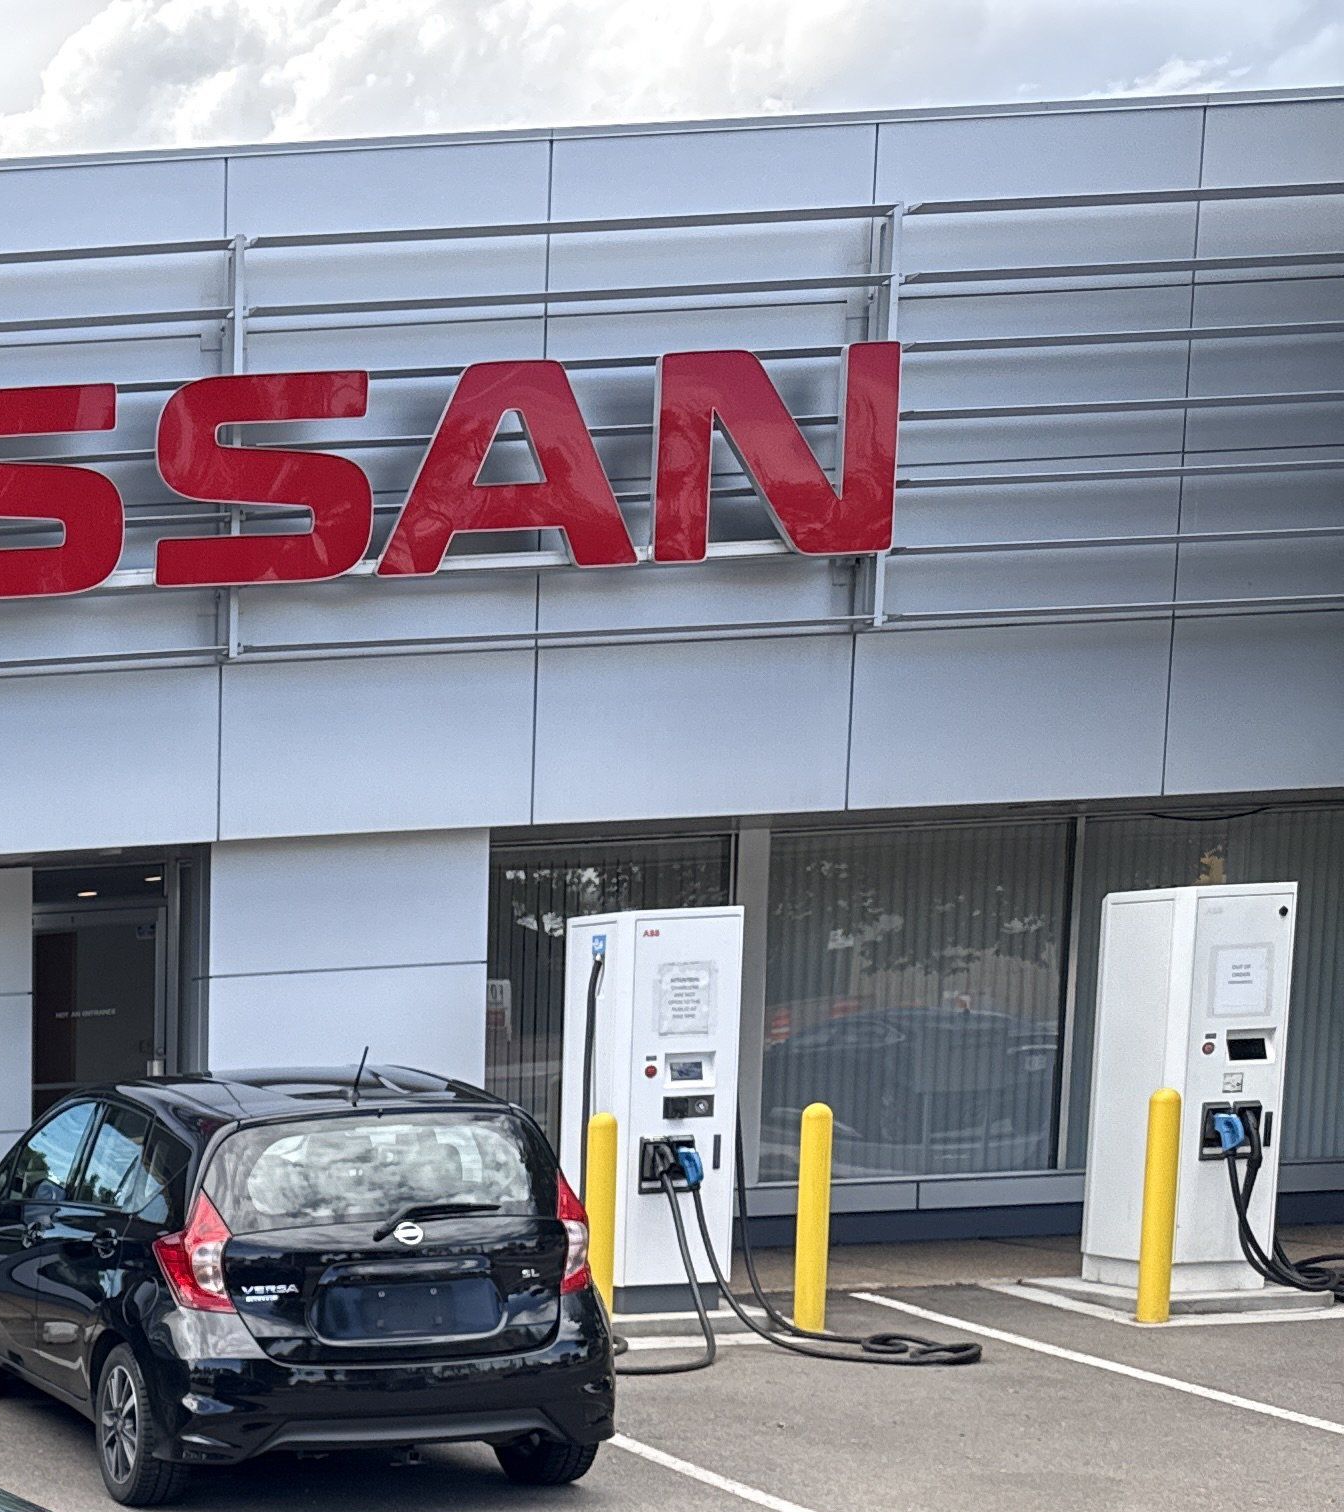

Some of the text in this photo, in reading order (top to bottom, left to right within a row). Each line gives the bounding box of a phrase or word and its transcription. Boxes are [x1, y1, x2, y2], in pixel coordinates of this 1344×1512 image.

[643, 929, 660, 937] ABB
[522, 1269, 540, 1278] SL
[241, 1284, 299, 1294] VERSA
